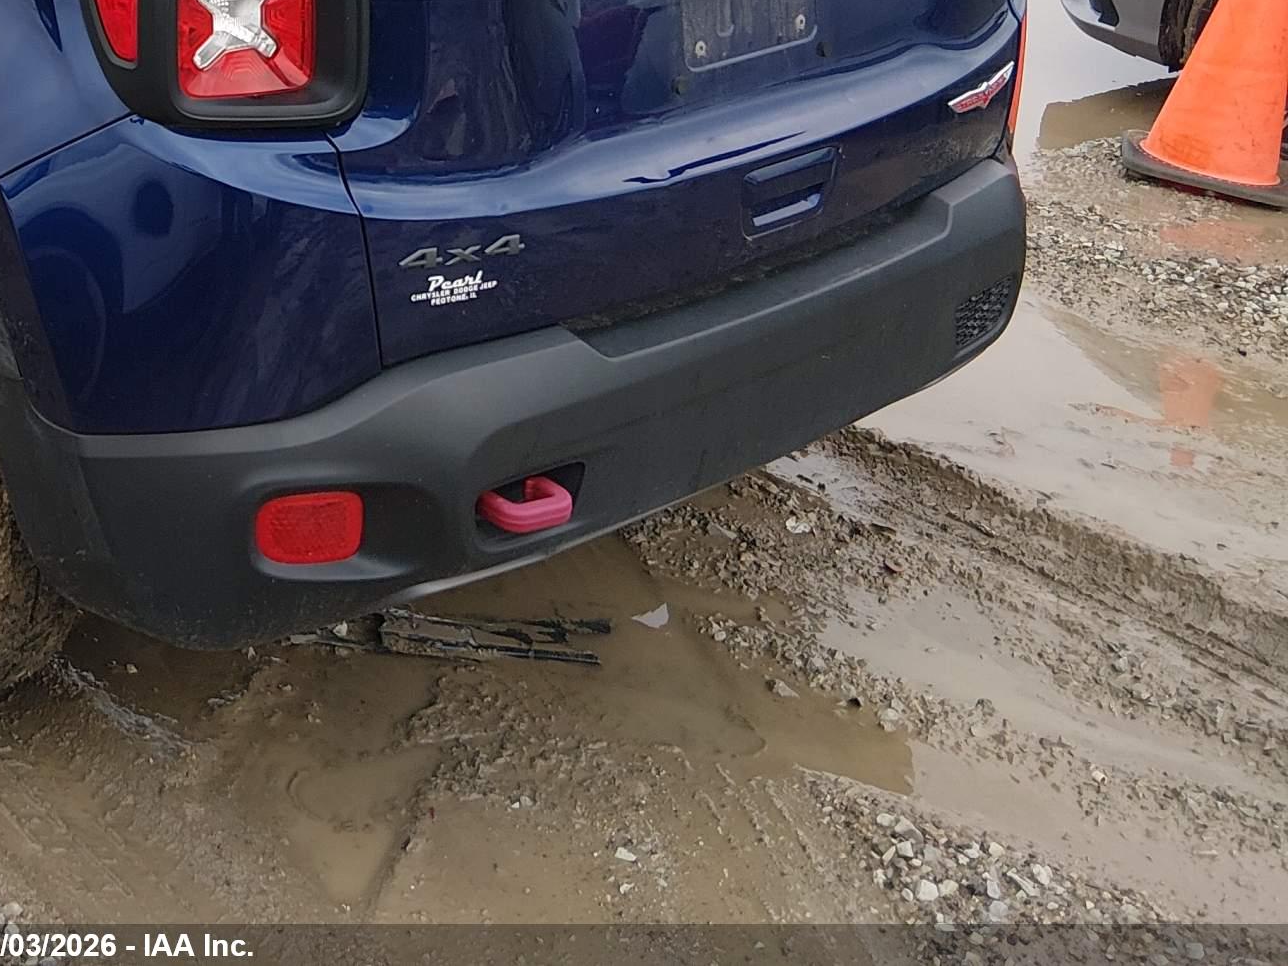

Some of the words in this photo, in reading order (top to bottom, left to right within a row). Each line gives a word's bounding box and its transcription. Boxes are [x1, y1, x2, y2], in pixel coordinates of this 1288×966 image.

[410, 289, 451, 302] CHRYSLER
[453, 284, 479, 295] DODGE
[479, 280, 498, 291] JEEP
[427, 270, 483, 292] Pearl
